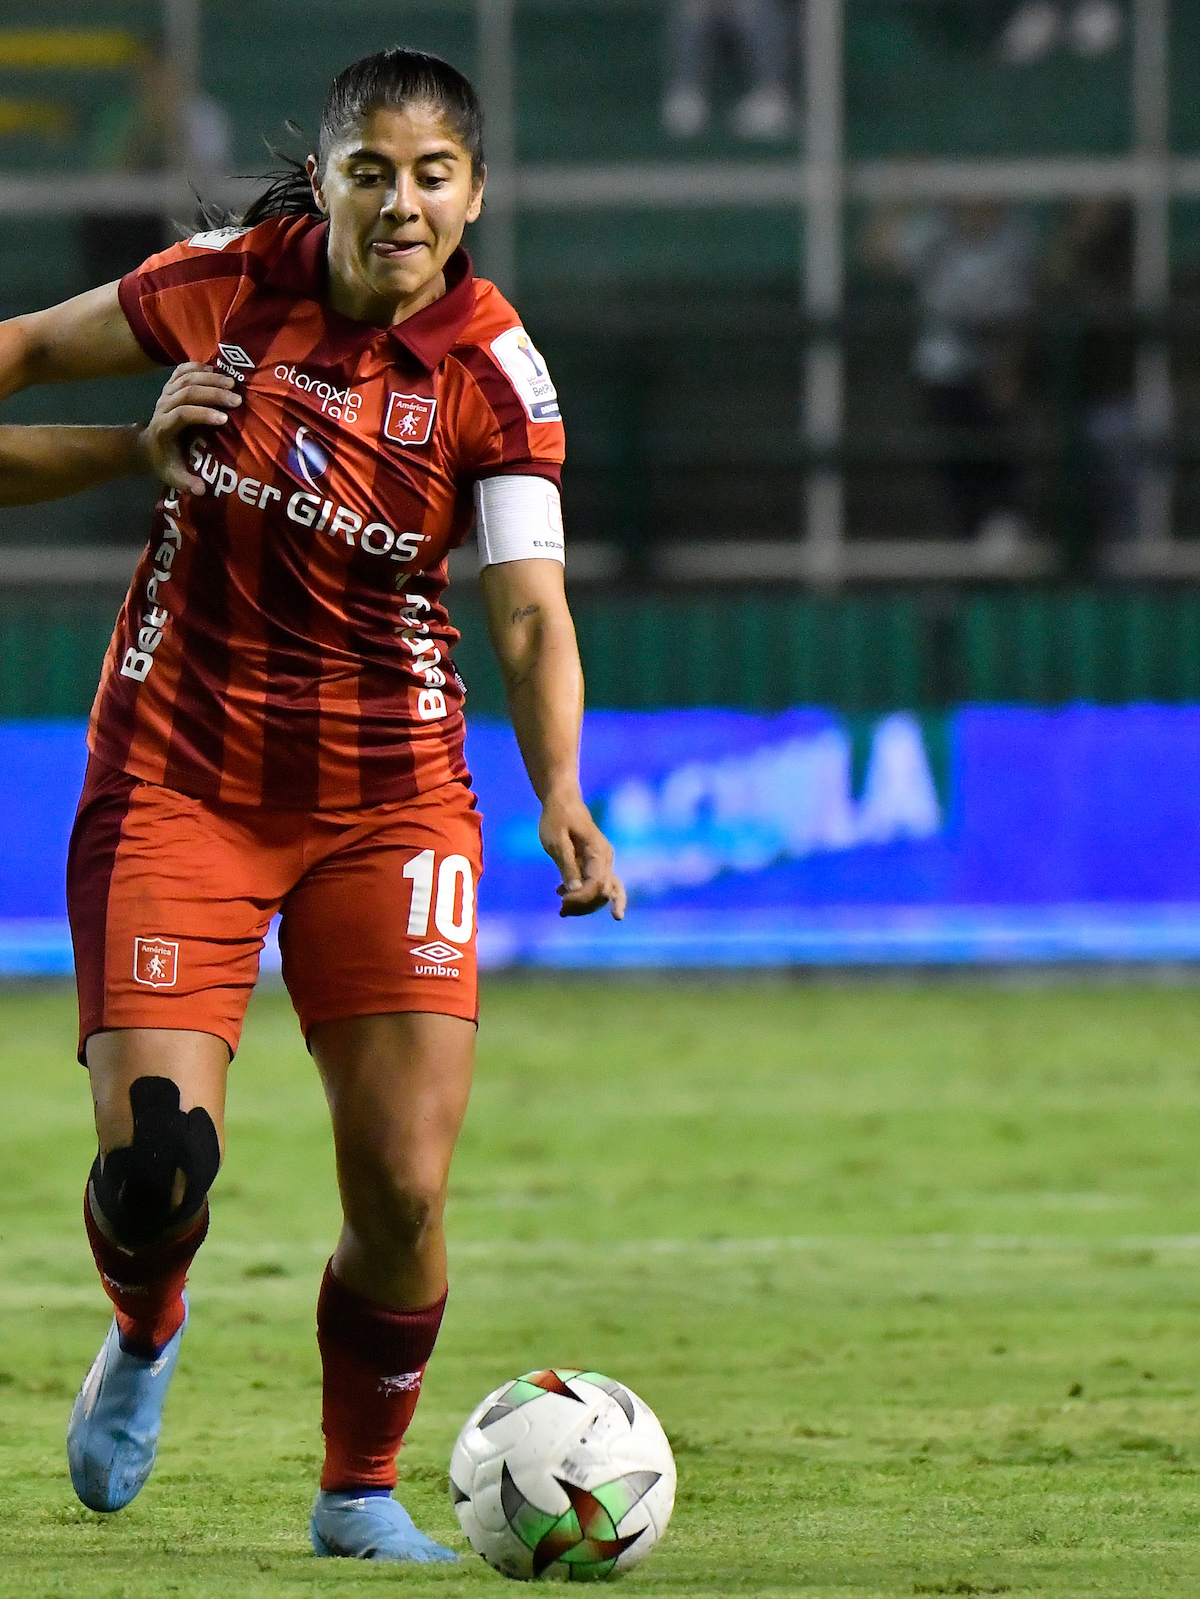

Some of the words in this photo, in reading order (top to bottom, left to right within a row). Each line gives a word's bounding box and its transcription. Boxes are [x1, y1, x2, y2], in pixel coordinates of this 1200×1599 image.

[274, 364, 363, 409] ataraxia
[321, 398, 358, 423] lab
[287, 490, 427, 563] GIROS
[402, 849, 474, 944] 10
[415, 964, 460, 978] umbro
